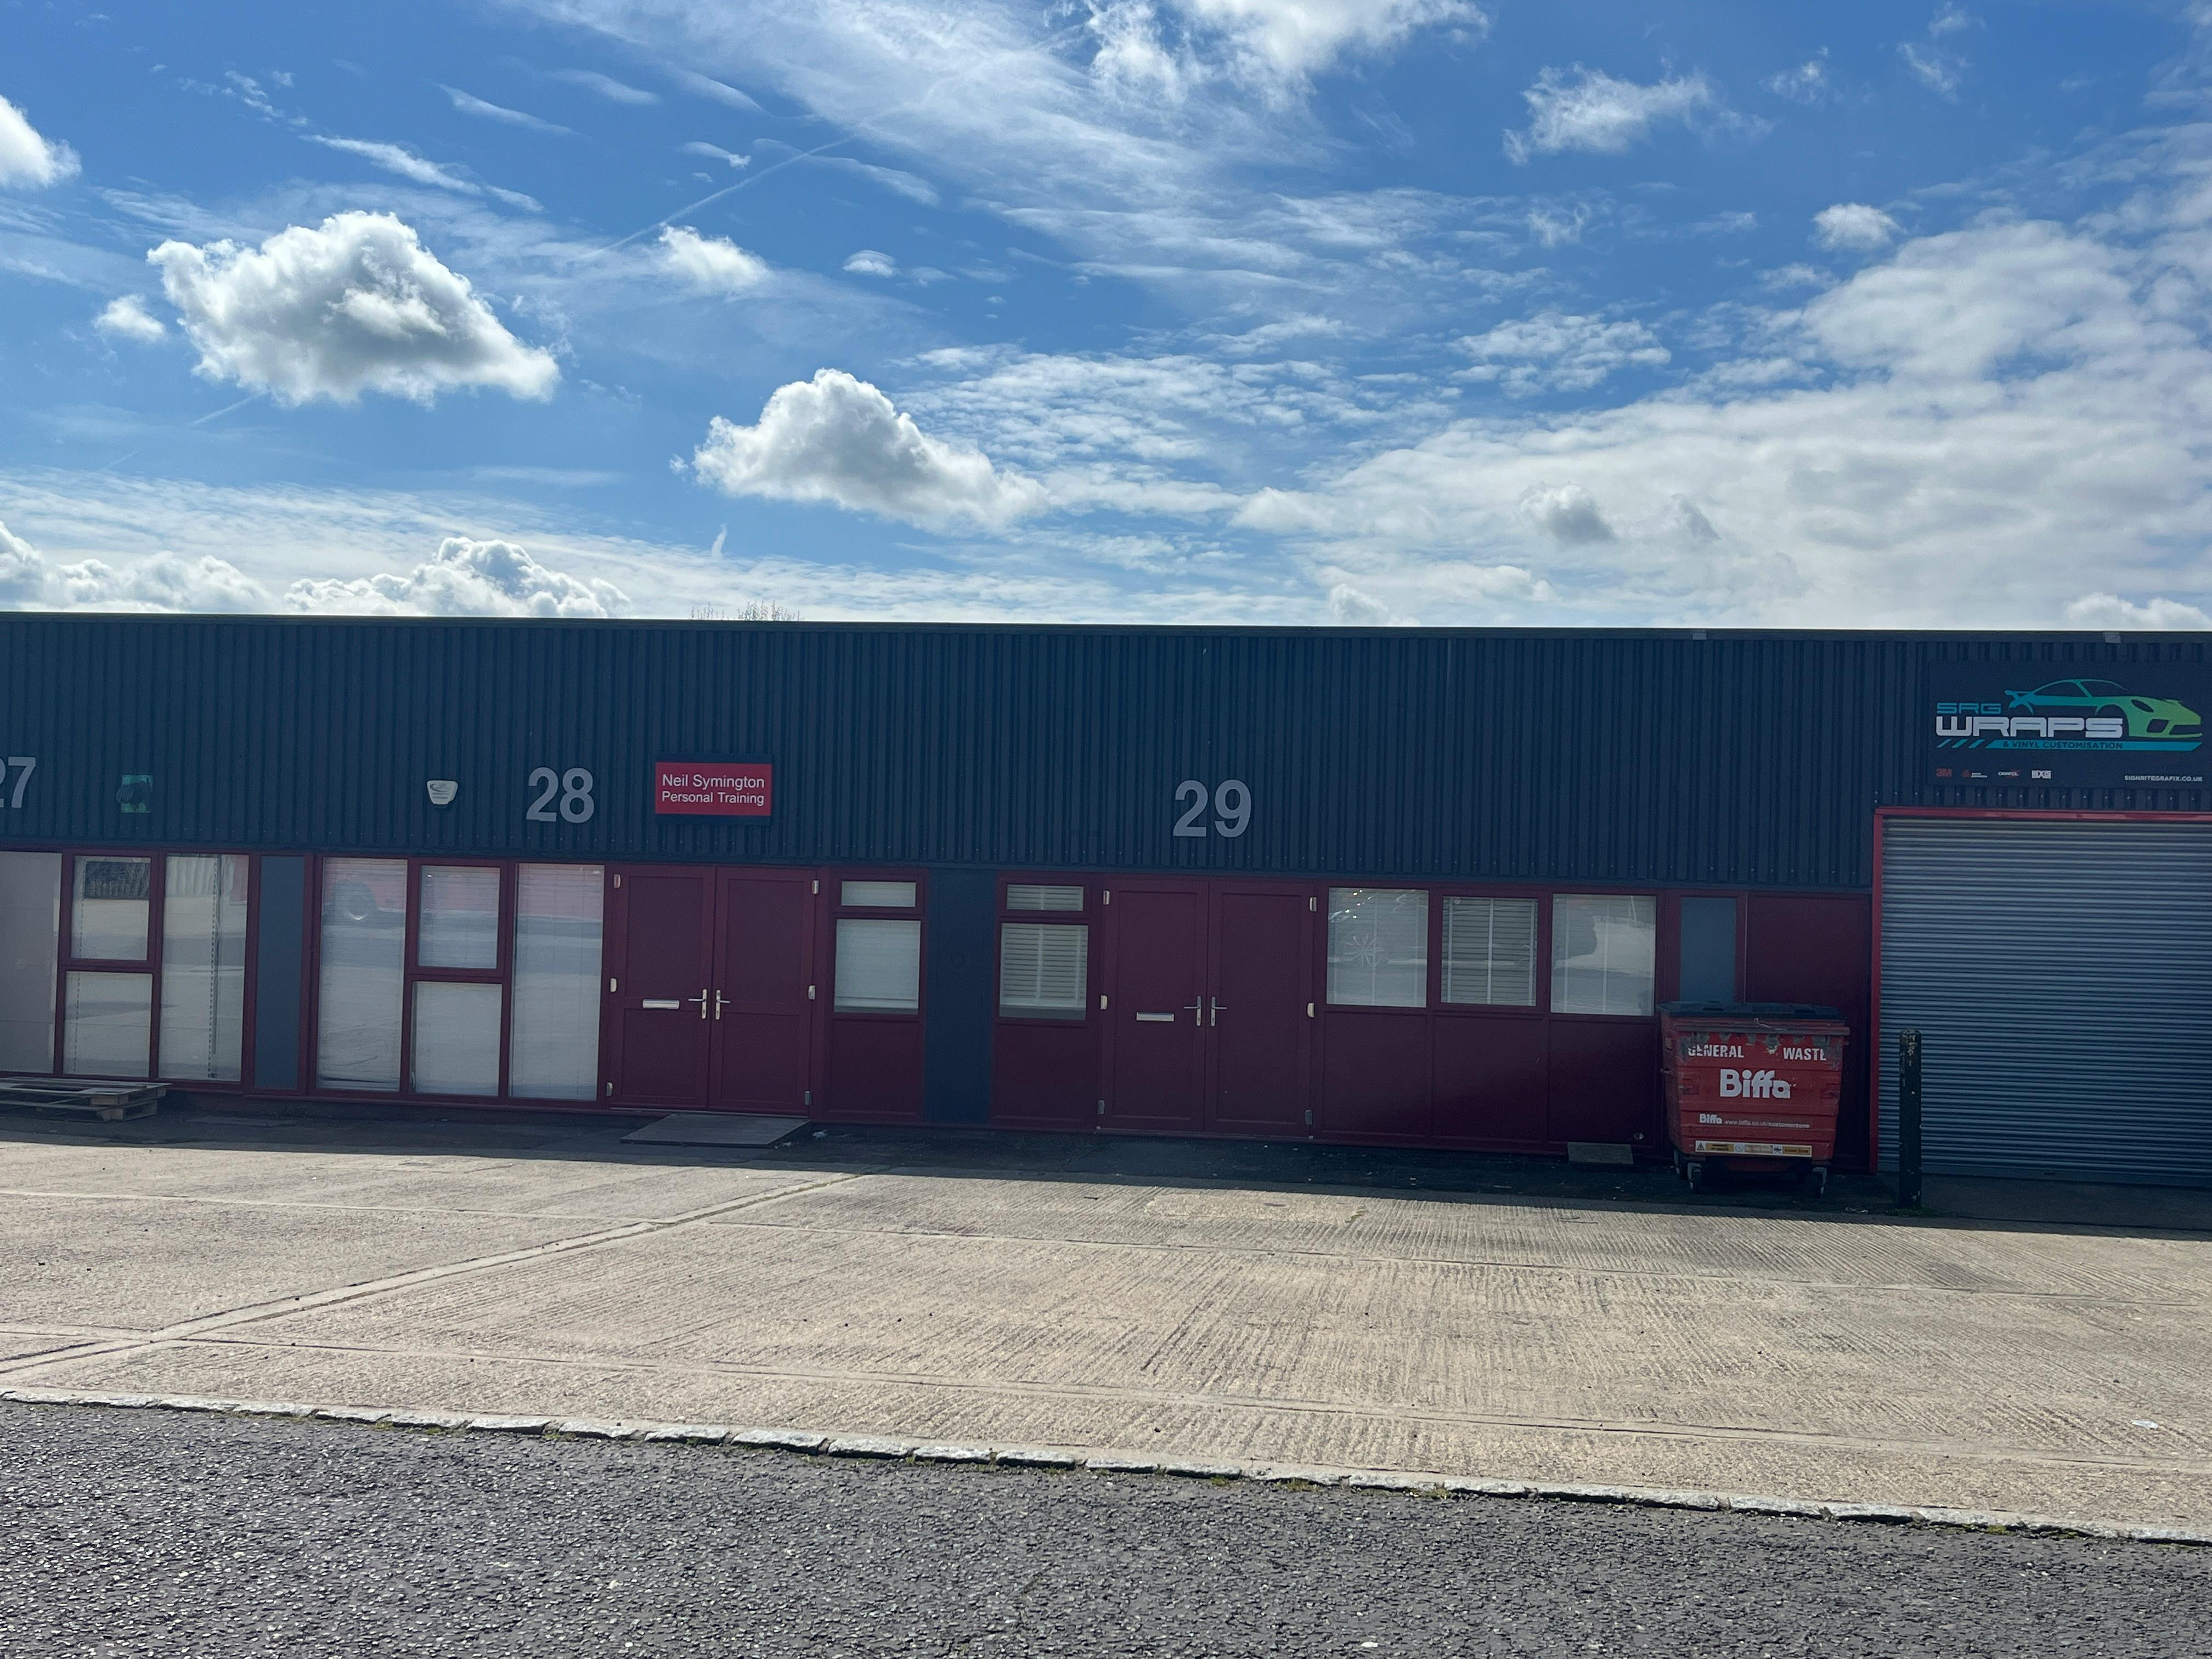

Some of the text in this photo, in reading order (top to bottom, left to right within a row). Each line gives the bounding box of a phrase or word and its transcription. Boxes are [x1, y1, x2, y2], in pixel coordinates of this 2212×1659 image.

[1936, 702, 2002, 714] SRG
[1936, 715, 2124, 738] WRAPS
[2042, 741, 2124, 749] CUSTOMISATION
[0, 757, 36, 809] 7
[662, 773, 765, 791] Neil Symington
[526, 766, 595, 823] 28
[662, 791, 765, 806] Personal Training
[1173, 779, 1252, 838] 29
[1720, 1069, 1791, 1099] Biffa
[1699, 1113, 1723, 1124] Biffa
